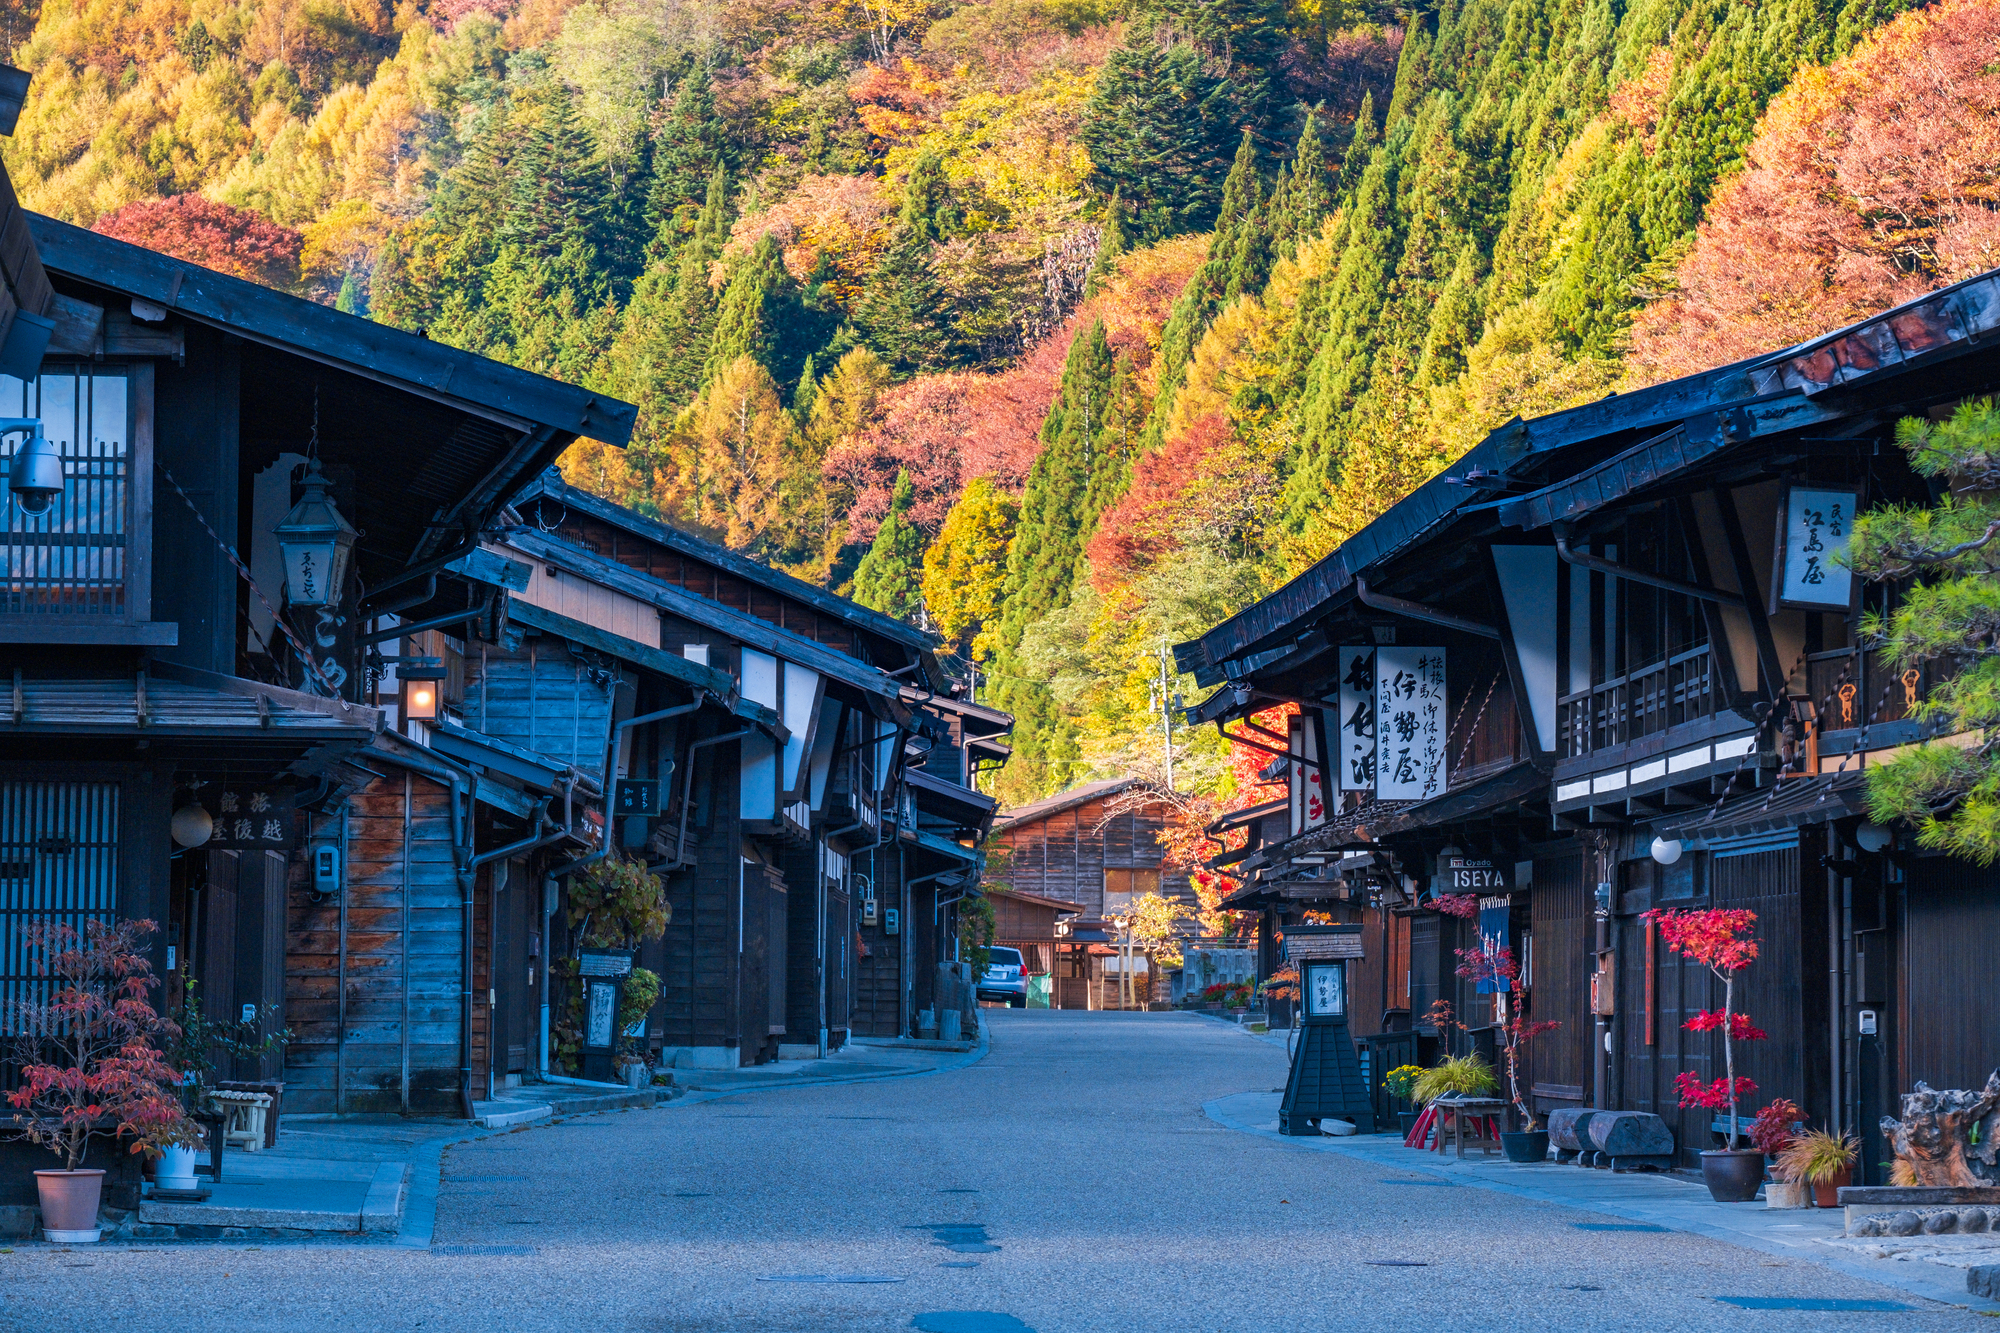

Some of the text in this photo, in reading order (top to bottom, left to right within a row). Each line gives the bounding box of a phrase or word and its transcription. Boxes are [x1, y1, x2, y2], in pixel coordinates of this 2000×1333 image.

[1830, 503, 1843, 536] 民宿
[1393, 670, 1421, 784] 伊勢屋
[1454, 870, 1504, 887] ISEYA
[1466, 859, 1492, 867] Oyado
[1317, 975, 1328, 1008] 伊勢屋
